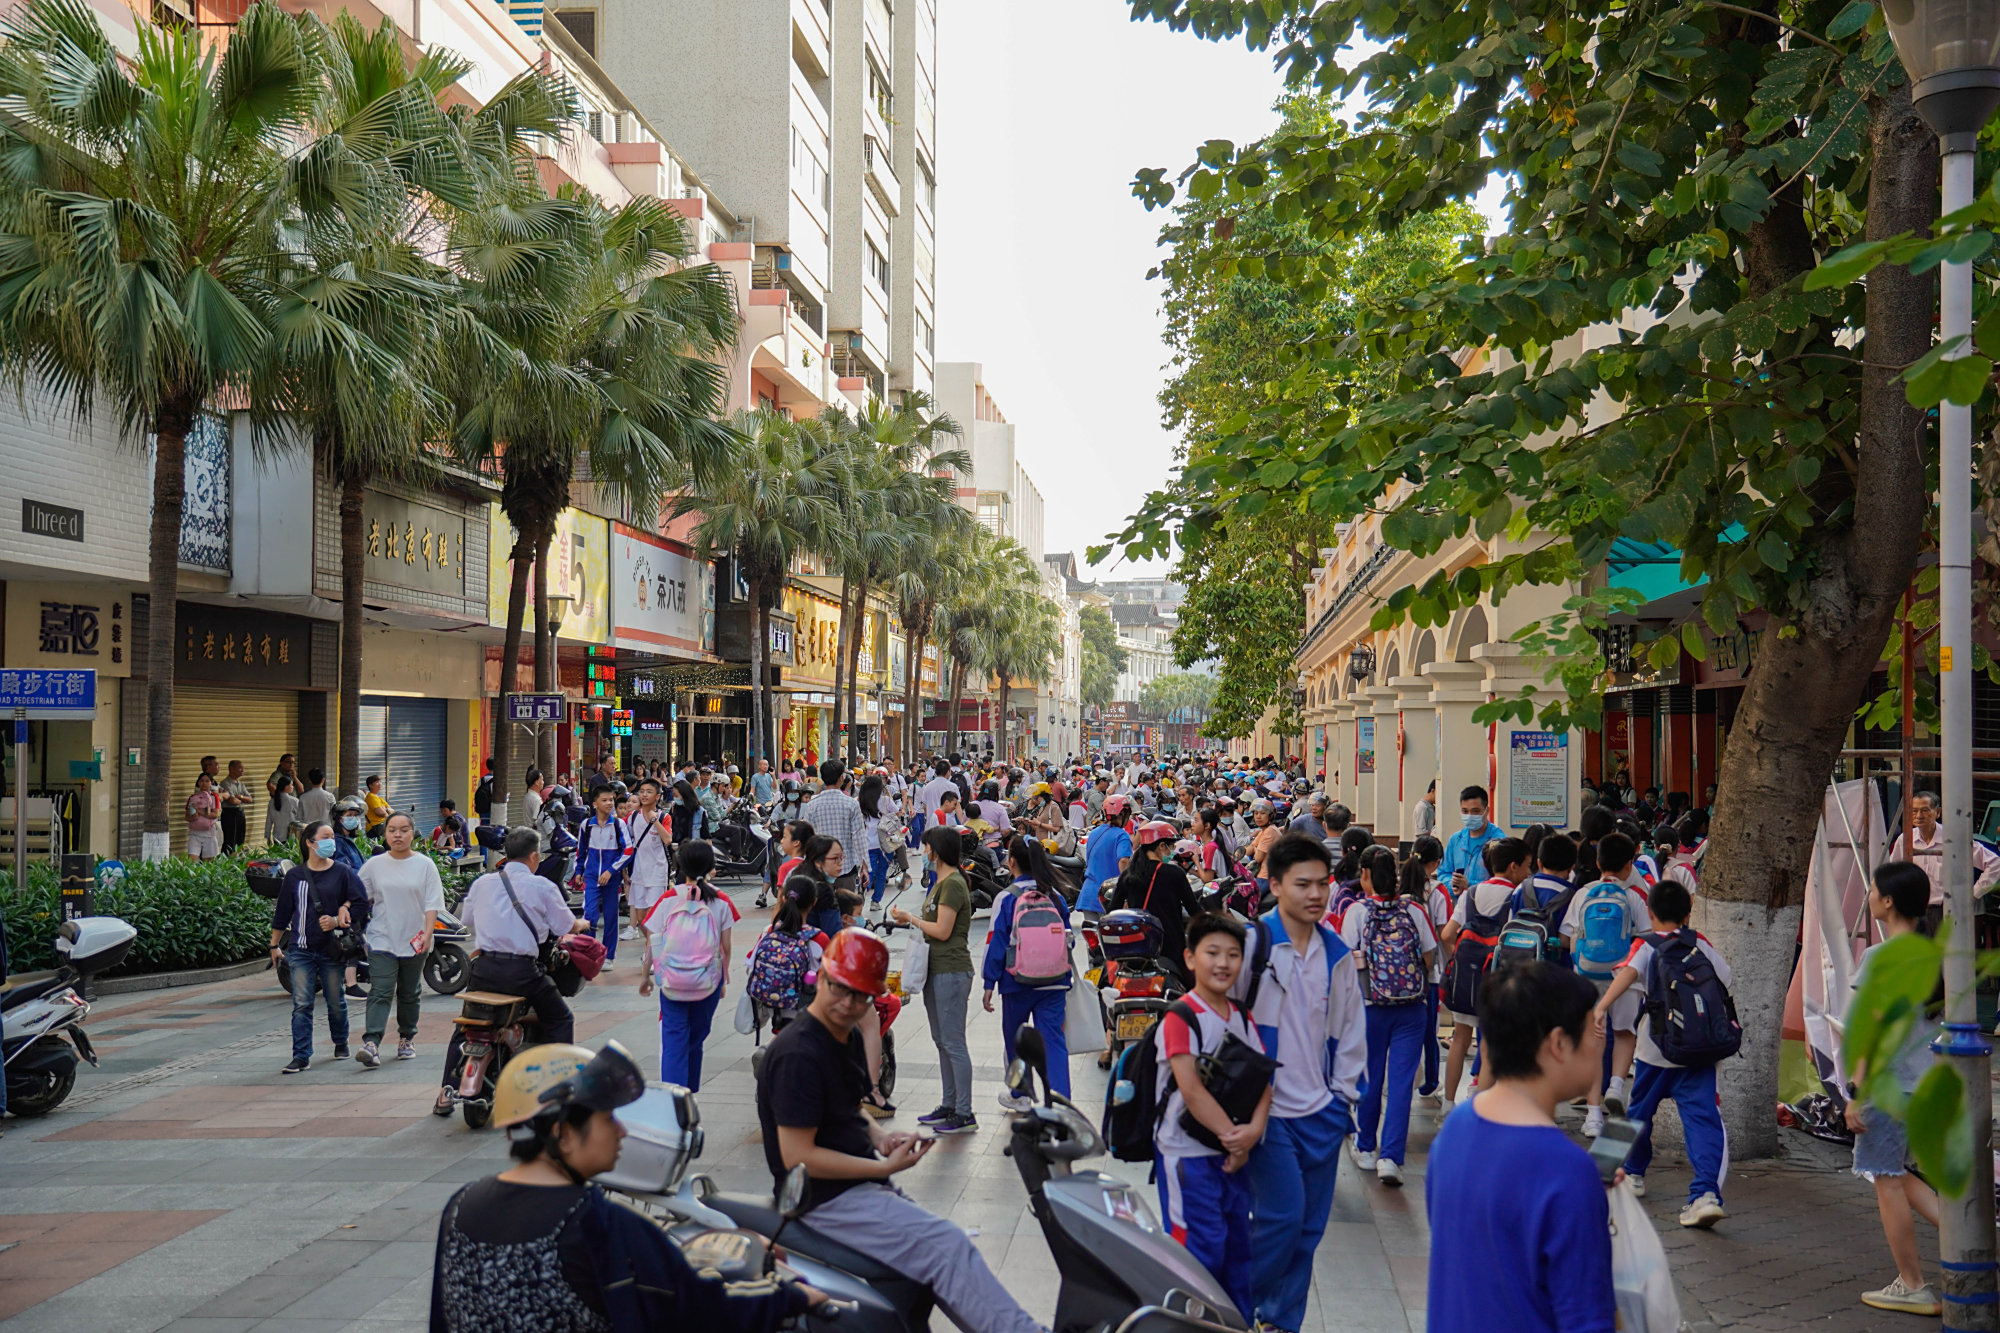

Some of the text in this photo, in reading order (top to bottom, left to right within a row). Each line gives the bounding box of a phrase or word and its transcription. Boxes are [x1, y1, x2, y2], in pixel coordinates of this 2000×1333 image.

[30, 505, 78, 537] Three d
[367, 518, 449, 572] 老北京布鞋
[571, 532, 586, 616] 5
[657, 573, 686, 615] 茶八戒
[202, 629, 289, 666] 老北京布鞋
[1, 672, 86, 695] 路步行街
[14, 696, 55, 705] PEDESTRIAN
